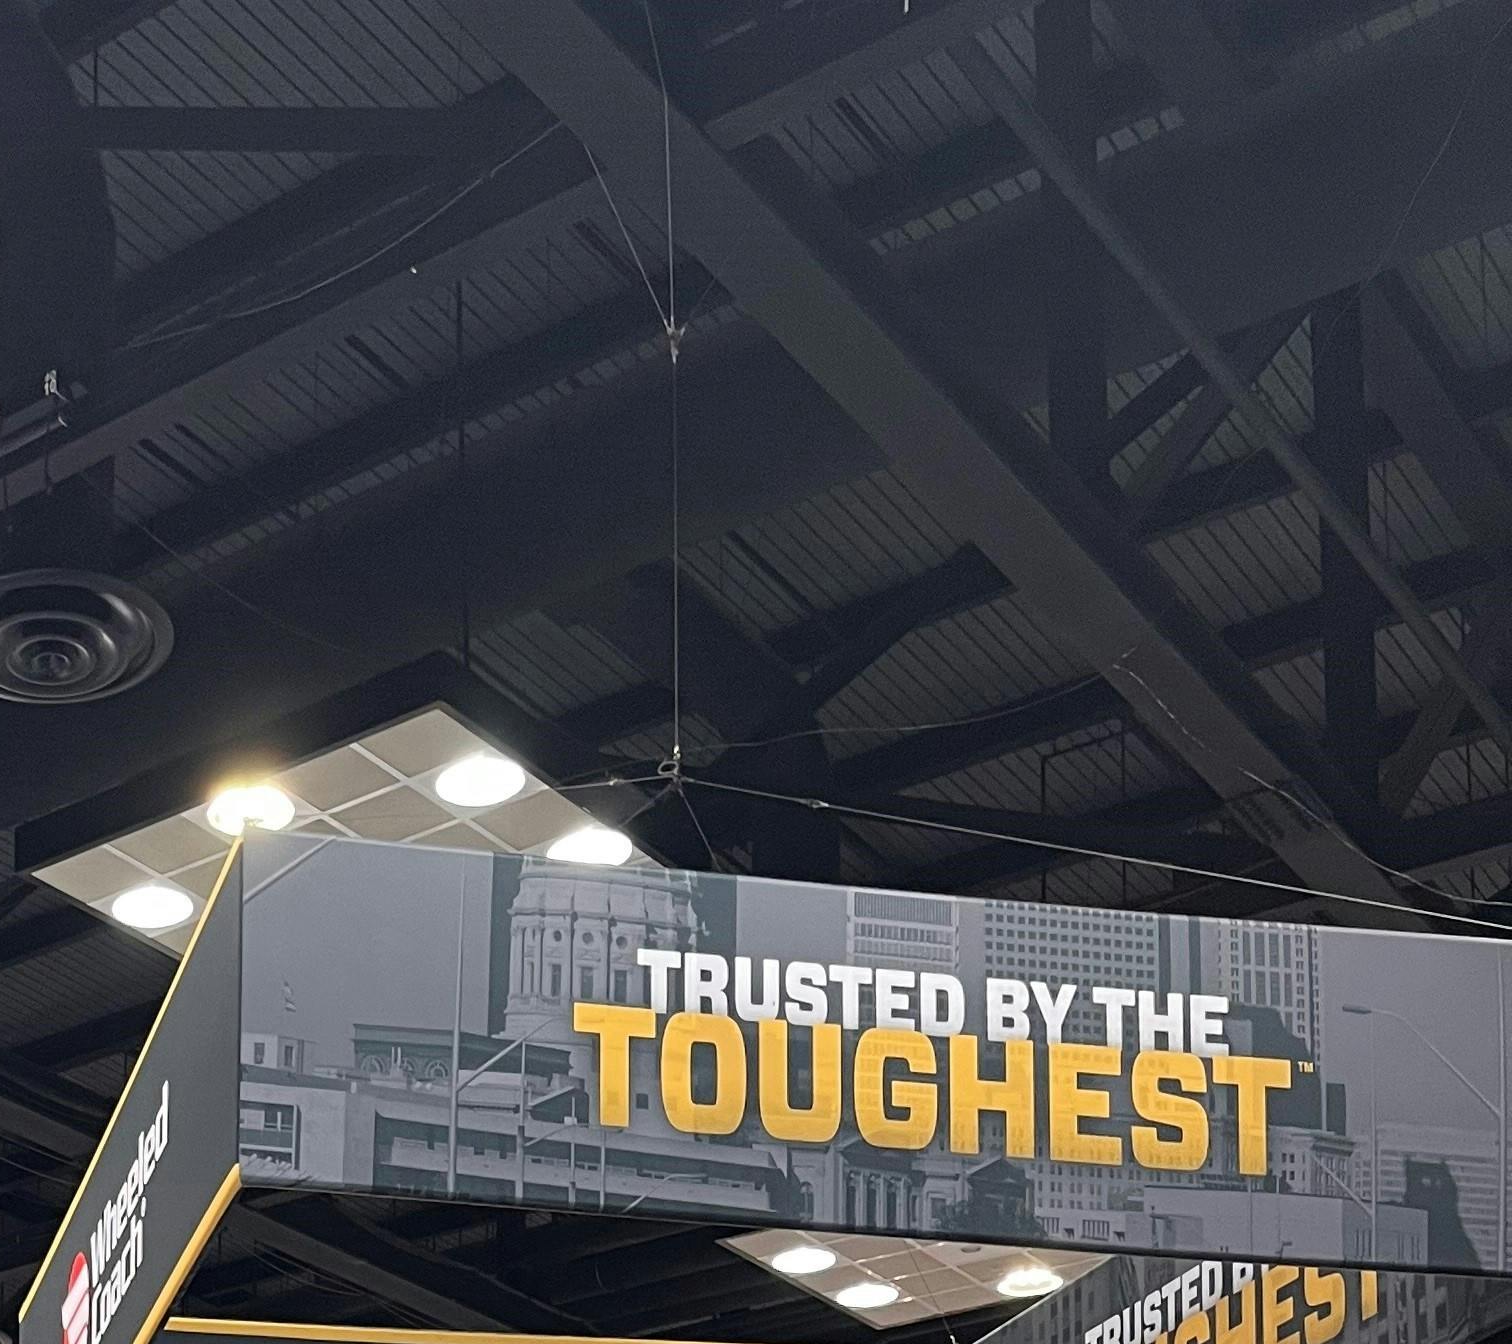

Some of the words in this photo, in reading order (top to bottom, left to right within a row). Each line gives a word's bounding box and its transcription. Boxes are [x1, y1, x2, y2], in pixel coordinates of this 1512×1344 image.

[637, 948, 966, 1037] TRUSTED
[986, 977, 1079, 1046] BY
[1091, 985, 1231, 1058] THE
[573, 1002, 1292, 1177] TOUGHEST
[90, 1079, 170, 1288] Wheeled
[1231, 1262, 1270, 1295] B
